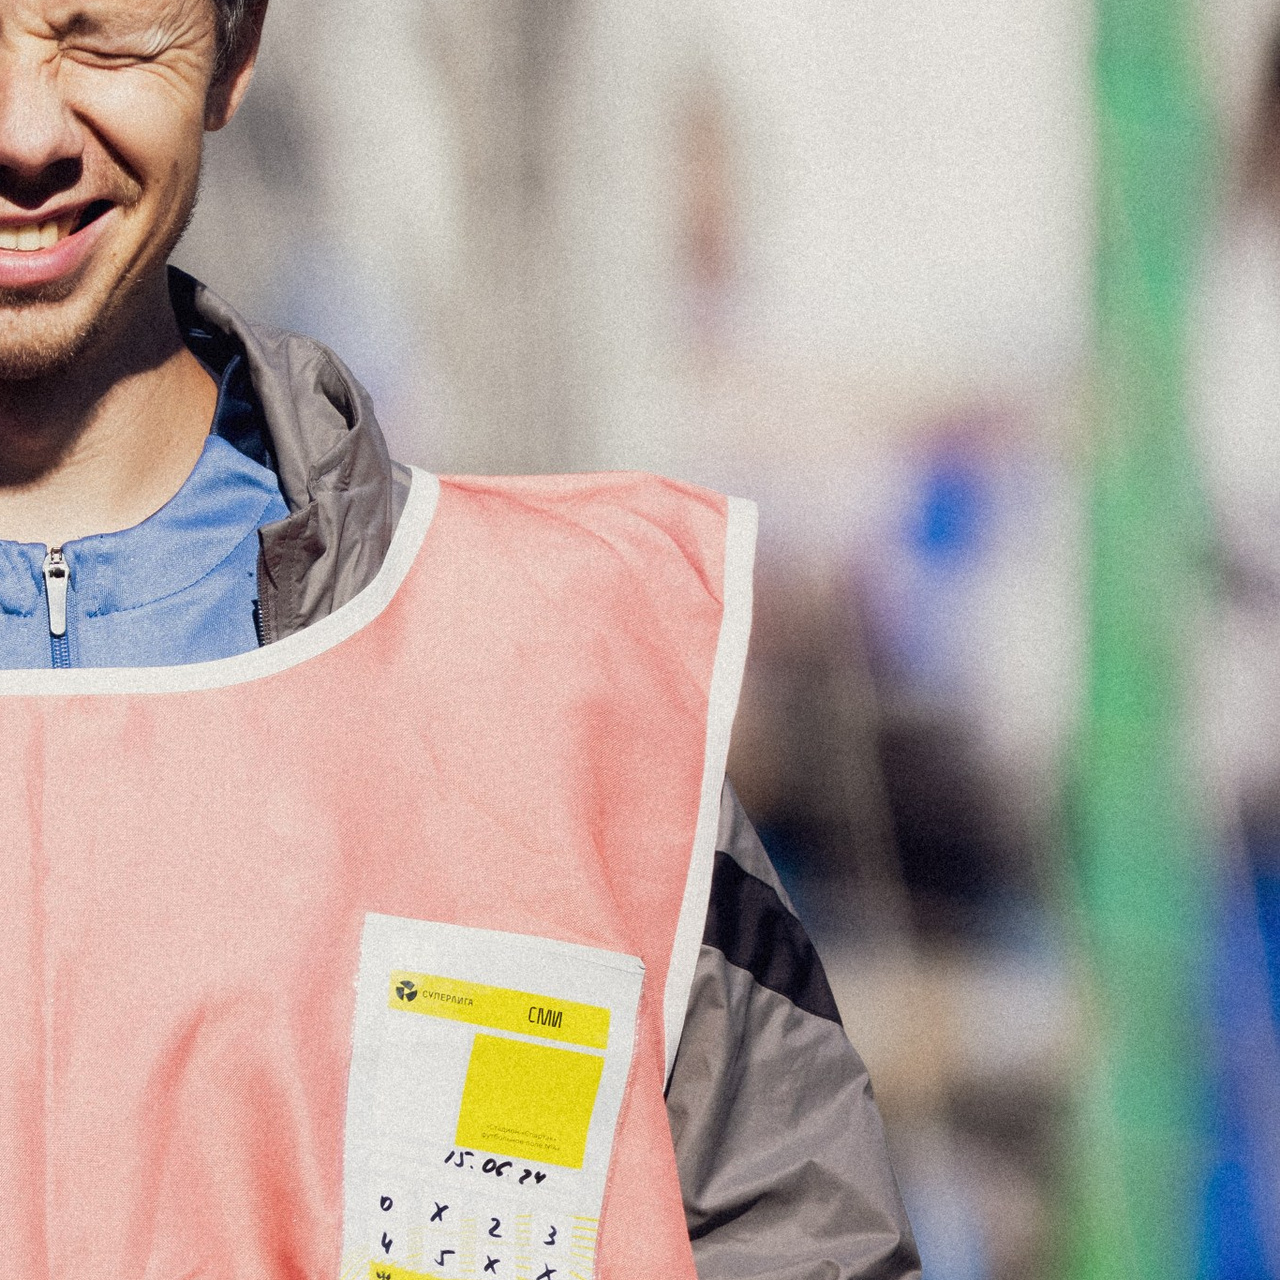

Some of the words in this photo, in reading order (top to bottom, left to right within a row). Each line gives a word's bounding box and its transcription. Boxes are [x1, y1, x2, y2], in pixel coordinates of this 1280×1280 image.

[422, 989, 474, 1007] СУПЕРЛИГА
[528, 1006, 563, 1029] СМИ
[488, 1217, 502, 1238] 2
[543, 1225, 557, 1246] 3
[381, 1232, 393, 1254] 4
[434, 1249, 455, 1266] 5
